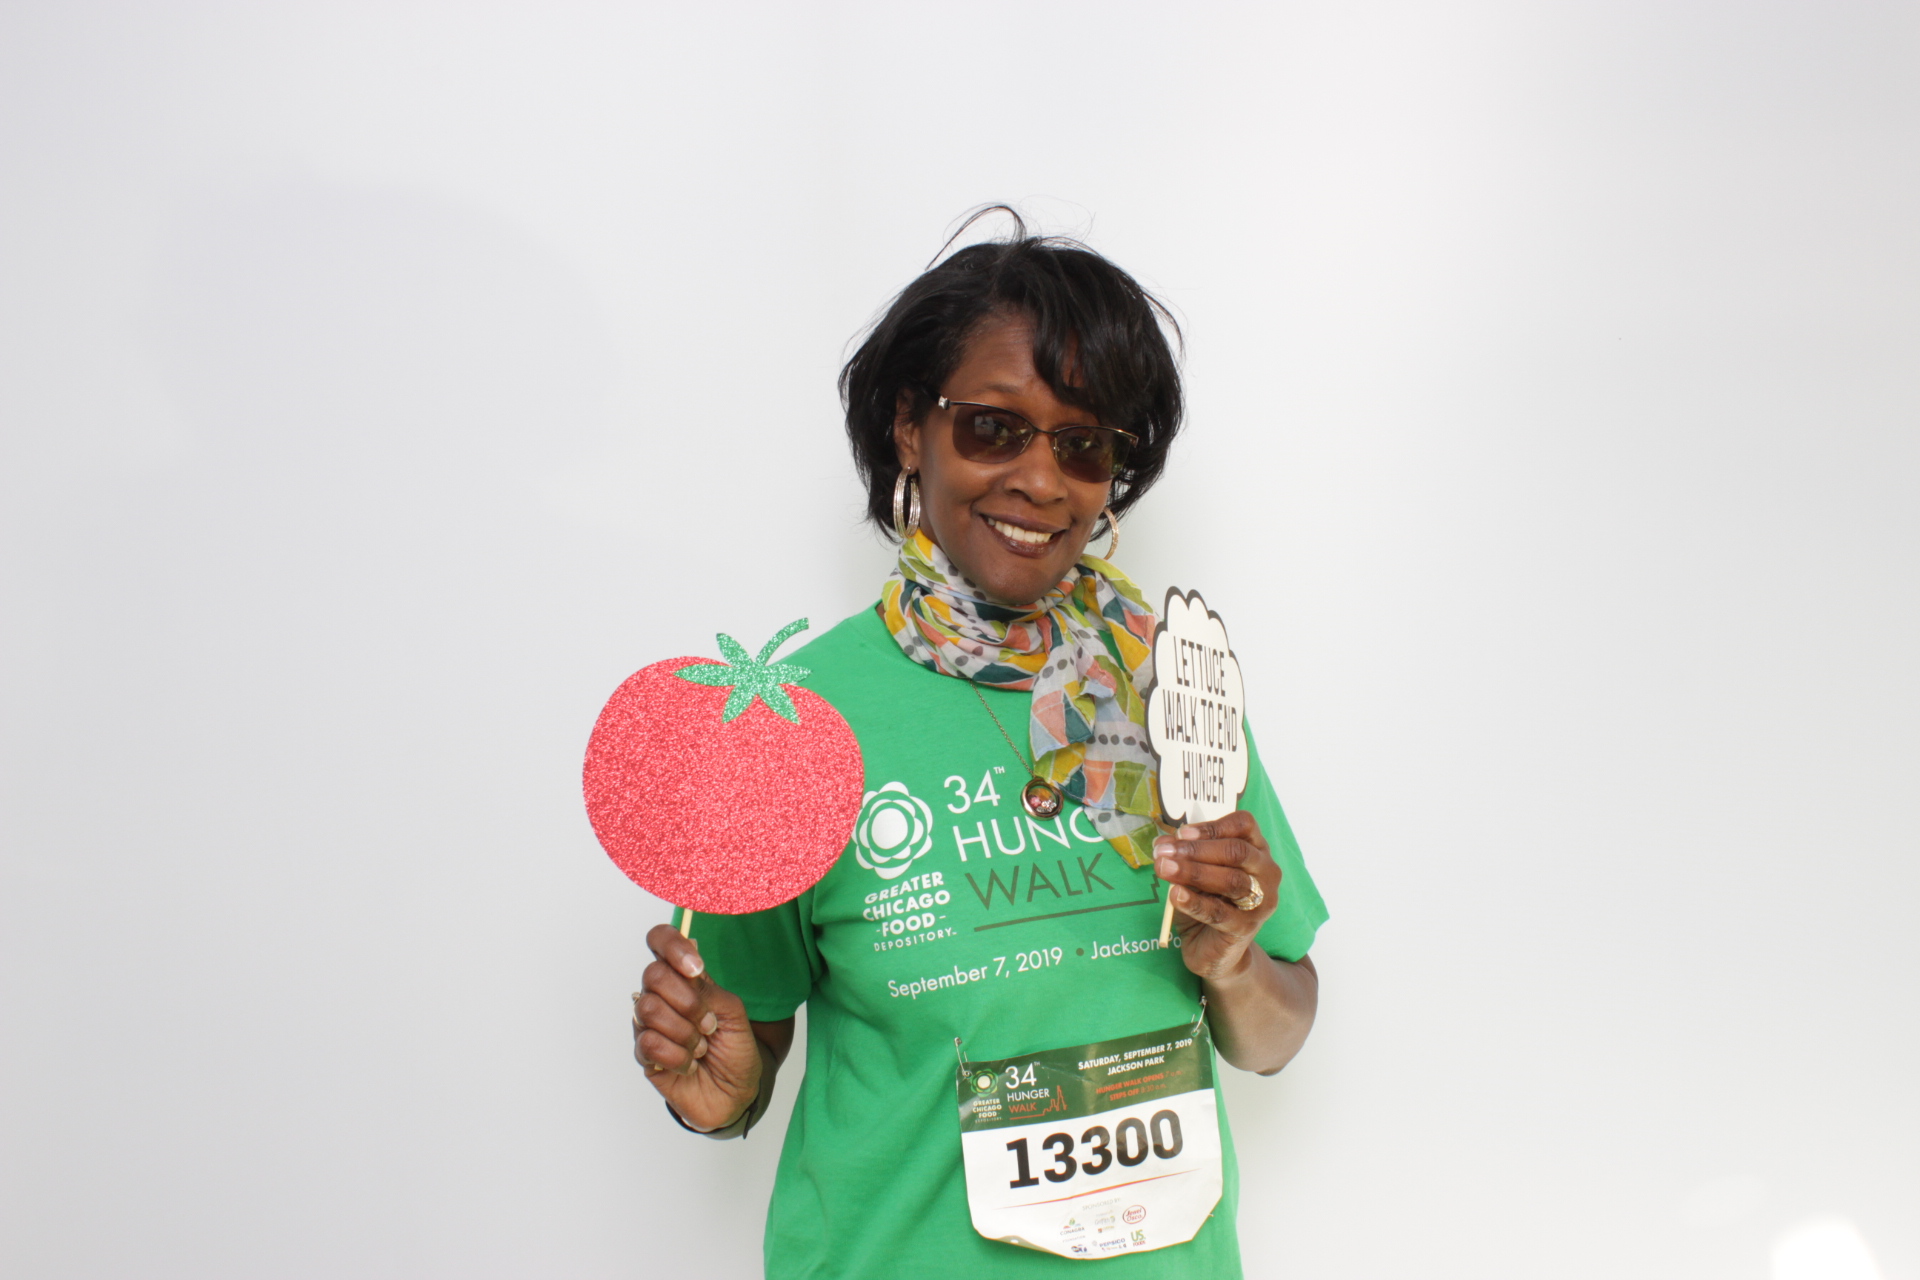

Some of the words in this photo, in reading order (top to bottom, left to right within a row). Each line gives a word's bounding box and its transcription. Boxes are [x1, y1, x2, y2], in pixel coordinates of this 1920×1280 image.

[1174, 635, 1226, 697] LETTUCE
[1163, 689, 1200, 745] WALK
[1201, 698, 1215, 748] TO
[1218, 703, 1238, 752] END
[1183, 750, 1225, 803] HUNGER
[864, 871, 945, 904] GREATER
[965, 853, 1115, 911] WALK
[862, 890, 951, 921] CHICAGO
[874, 927, 953, 951] DEPOSITORY
[888, 965, 988, 999] September
[993, 956, 1010, 978] 7,
[1015, 947, 1063, 972] 2019
[1091, 935, 1159, 960] Jackson
[1078, 1054, 1121, 1070] SATURDAY,
[1123, 1044, 1165, 1060] SEPTEMBER
[1175, 1038, 1193, 1049] 2019
[1107, 1059, 1143, 1075] JACKSON
[1144, 1056, 1165, 1067] PARK
[1007, 1088, 1050, 1102] HUNGER
[1096, 1082, 1123, 1094] HUNGER
[1123, 1078, 1142, 1087] WALK
[1143, 1073, 1164, 1083] OPENS
[1109, 1089, 1127, 1101] STEPS
[1127, 1088, 1140, 1097] OFF
[972, 1104, 1003, 1113] CHICAGO
[973, 1098, 1001, 1107] GREATER
[1008, 1102, 1038, 1113] WALK
[1006, 1109, 1184, 1189] 13300
